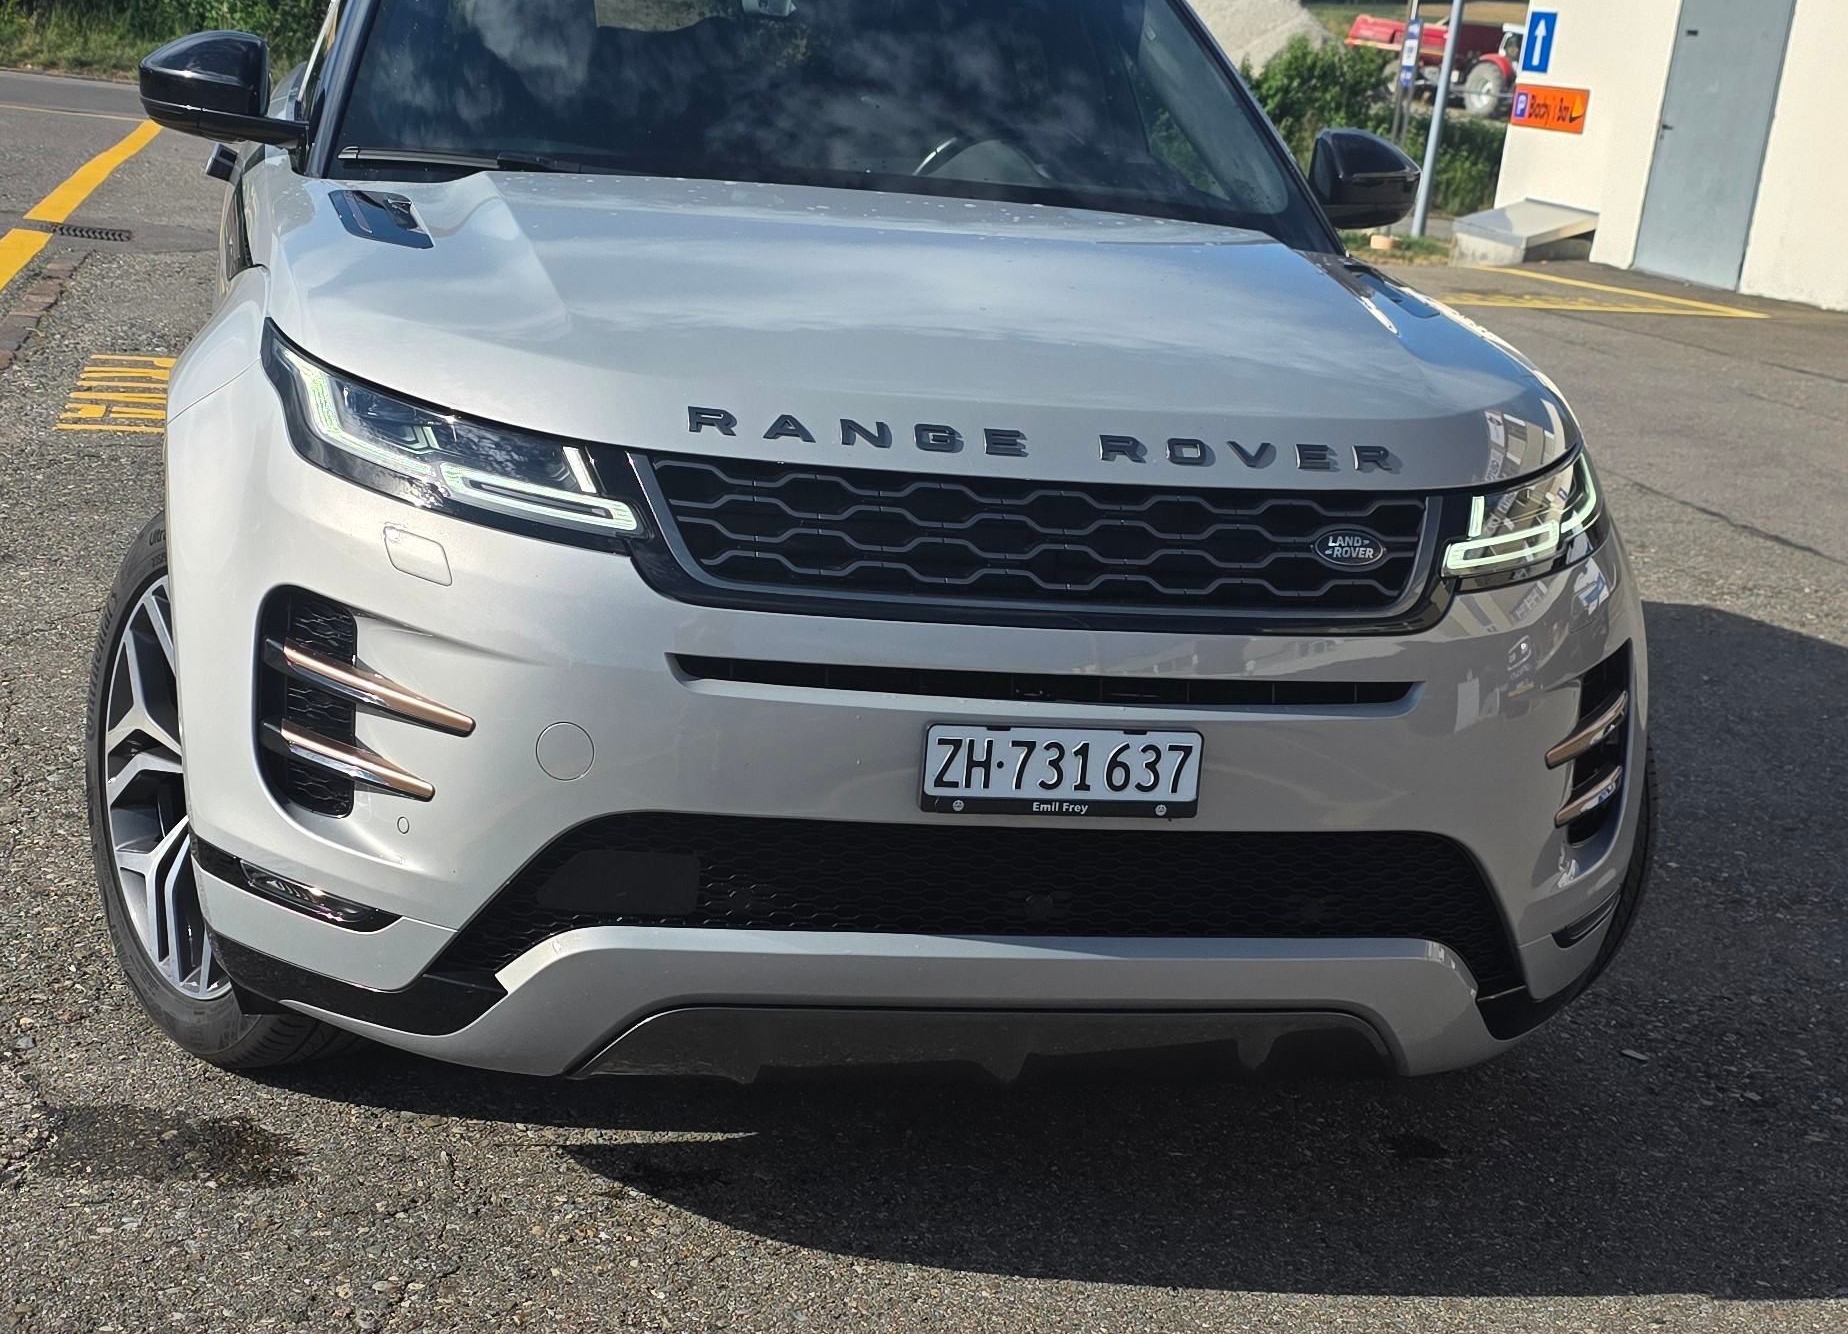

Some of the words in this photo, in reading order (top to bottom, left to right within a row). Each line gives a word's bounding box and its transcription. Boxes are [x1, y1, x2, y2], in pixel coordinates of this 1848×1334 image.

[688, 405, 1027, 457] RANGE
[1099, 434, 1394, 471] ROVER
[1328, 536, 1362, 547] LAND
[1333, 547, 1374, 559] ROVER
[1032, 801, 1060, 812] Emil
[1062, 802, 1088, 814] Frey
